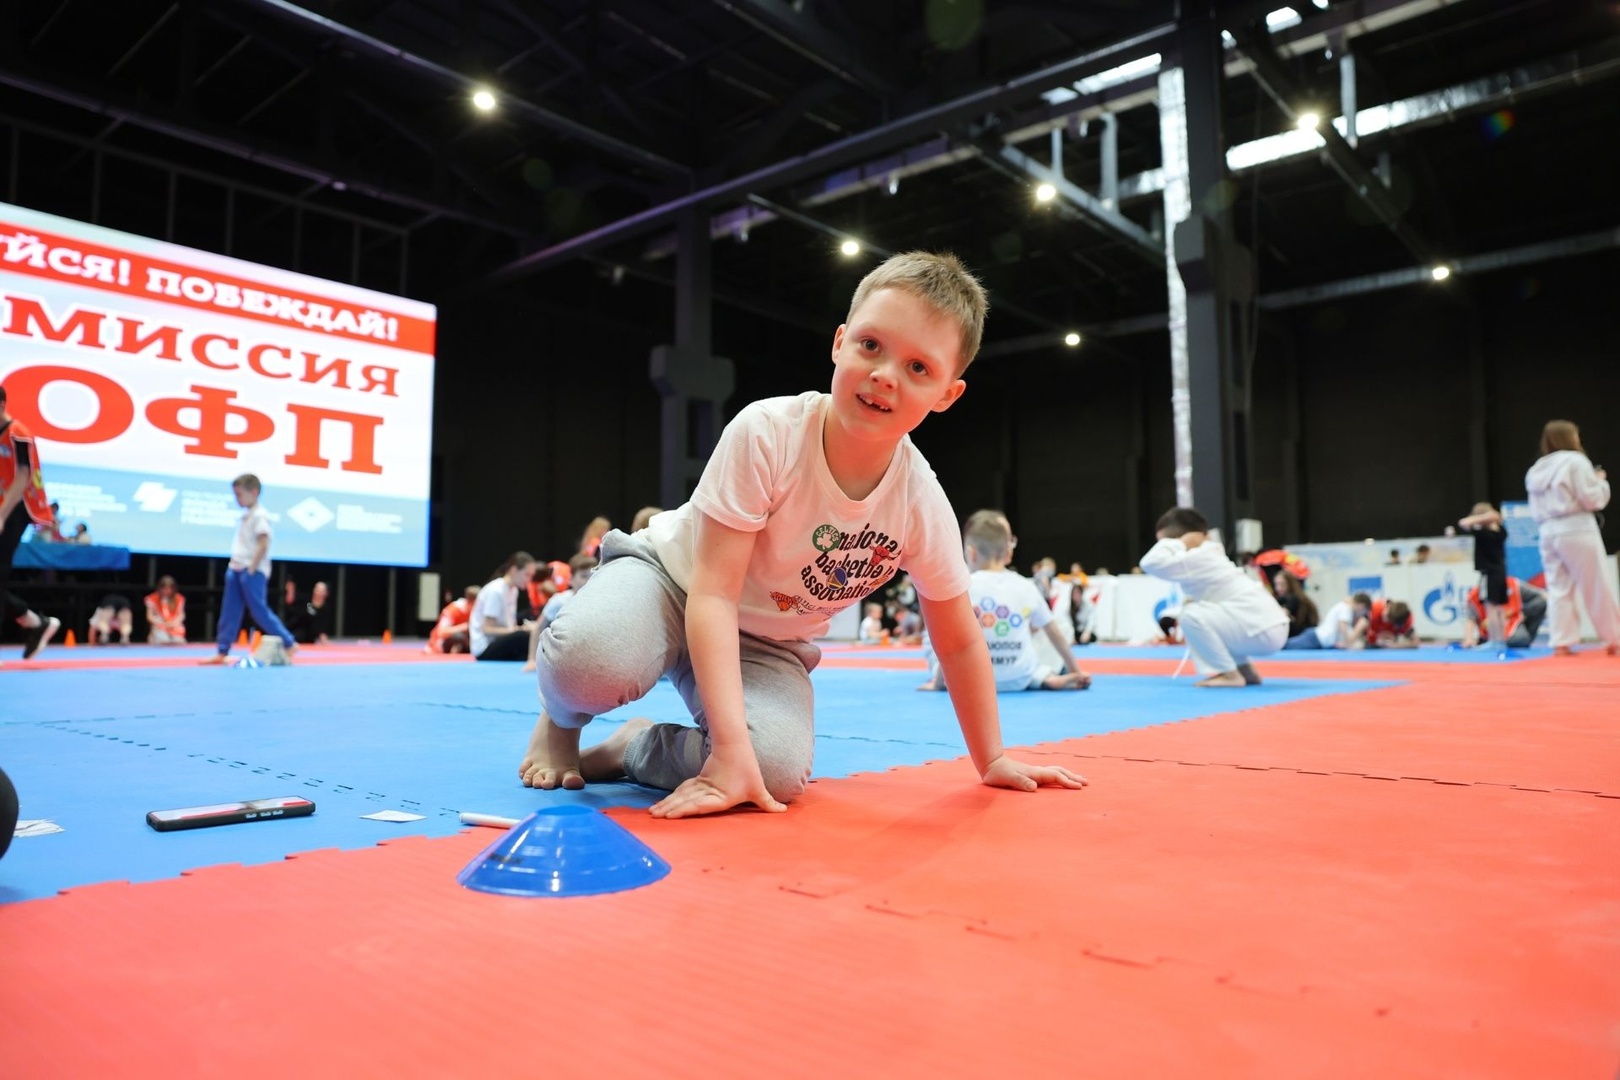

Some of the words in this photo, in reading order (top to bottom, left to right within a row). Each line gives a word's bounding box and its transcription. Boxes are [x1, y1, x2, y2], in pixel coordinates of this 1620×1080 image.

[0, 231, 131, 286] ЙСЯ!
[145, 267, 399, 341] ПОБЕЖДАЙ!
[3, 296, 400, 397] МИССИЯ
[0, 365, 384, 475] ОФП
[801, 565, 873, 601] associatio
[815, 525, 839, 542] CELTICS
